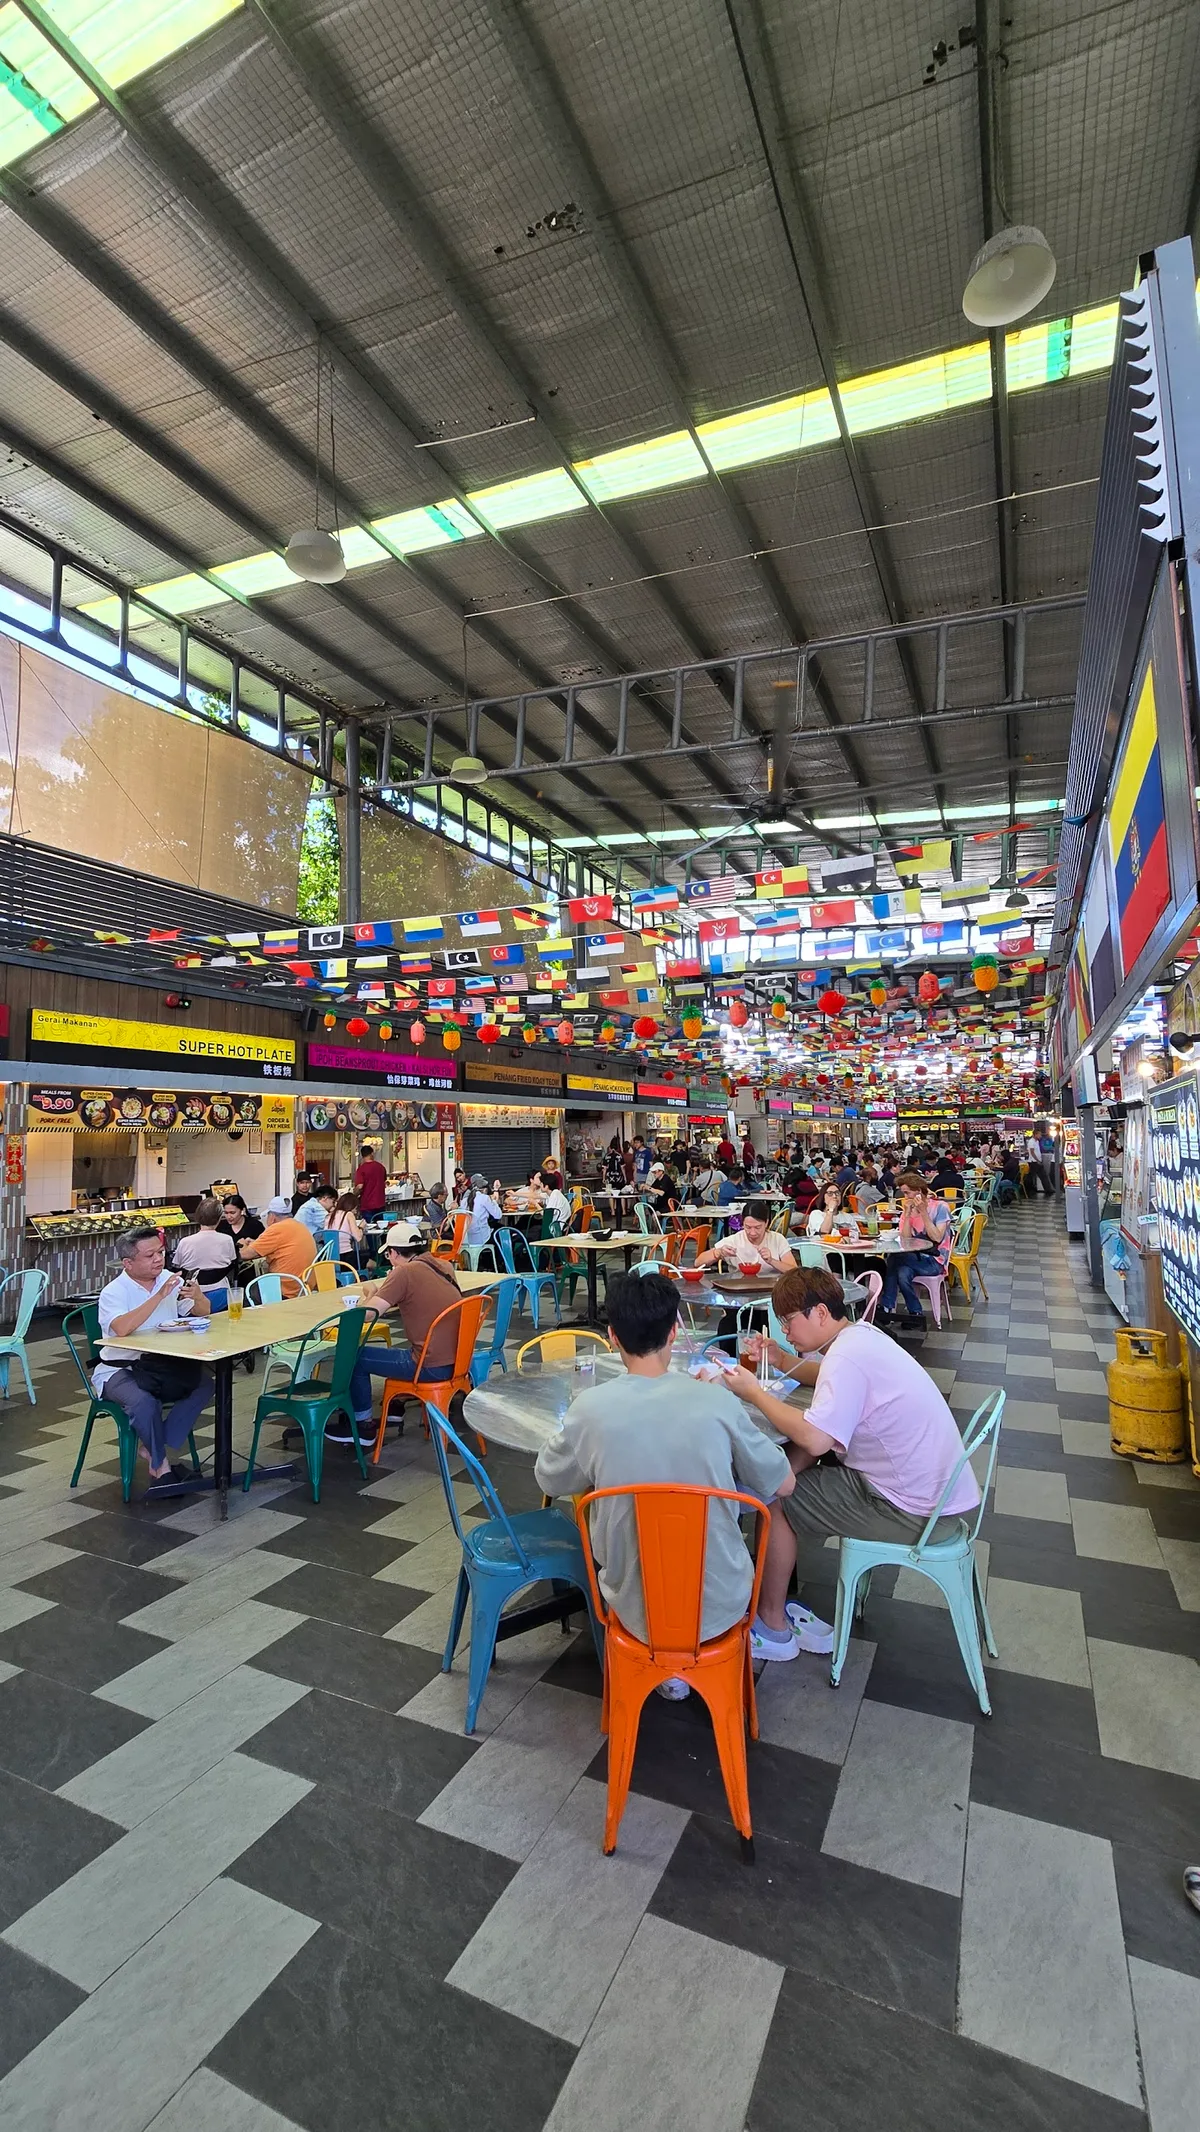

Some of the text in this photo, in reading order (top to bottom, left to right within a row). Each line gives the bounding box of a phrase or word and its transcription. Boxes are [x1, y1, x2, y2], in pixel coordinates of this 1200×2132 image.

[37, 1014, 98, 1028] Gerai Makanan
[179, 1039, 292, 1062] SUPER HOT PLATE
[316, 1053, 333, 1065] IPOH
[335, 1054, 379, 1070] BEANSPROUT
[262, 1064, 292, 1077] 铁板烧
[493, 1072, 517, 1083] PENANG
[517, 1075, 532, 1084] FRIED
[593, 1083, 609, 1091] PENANG
[42, 1097, 75, 1110] 9.90
